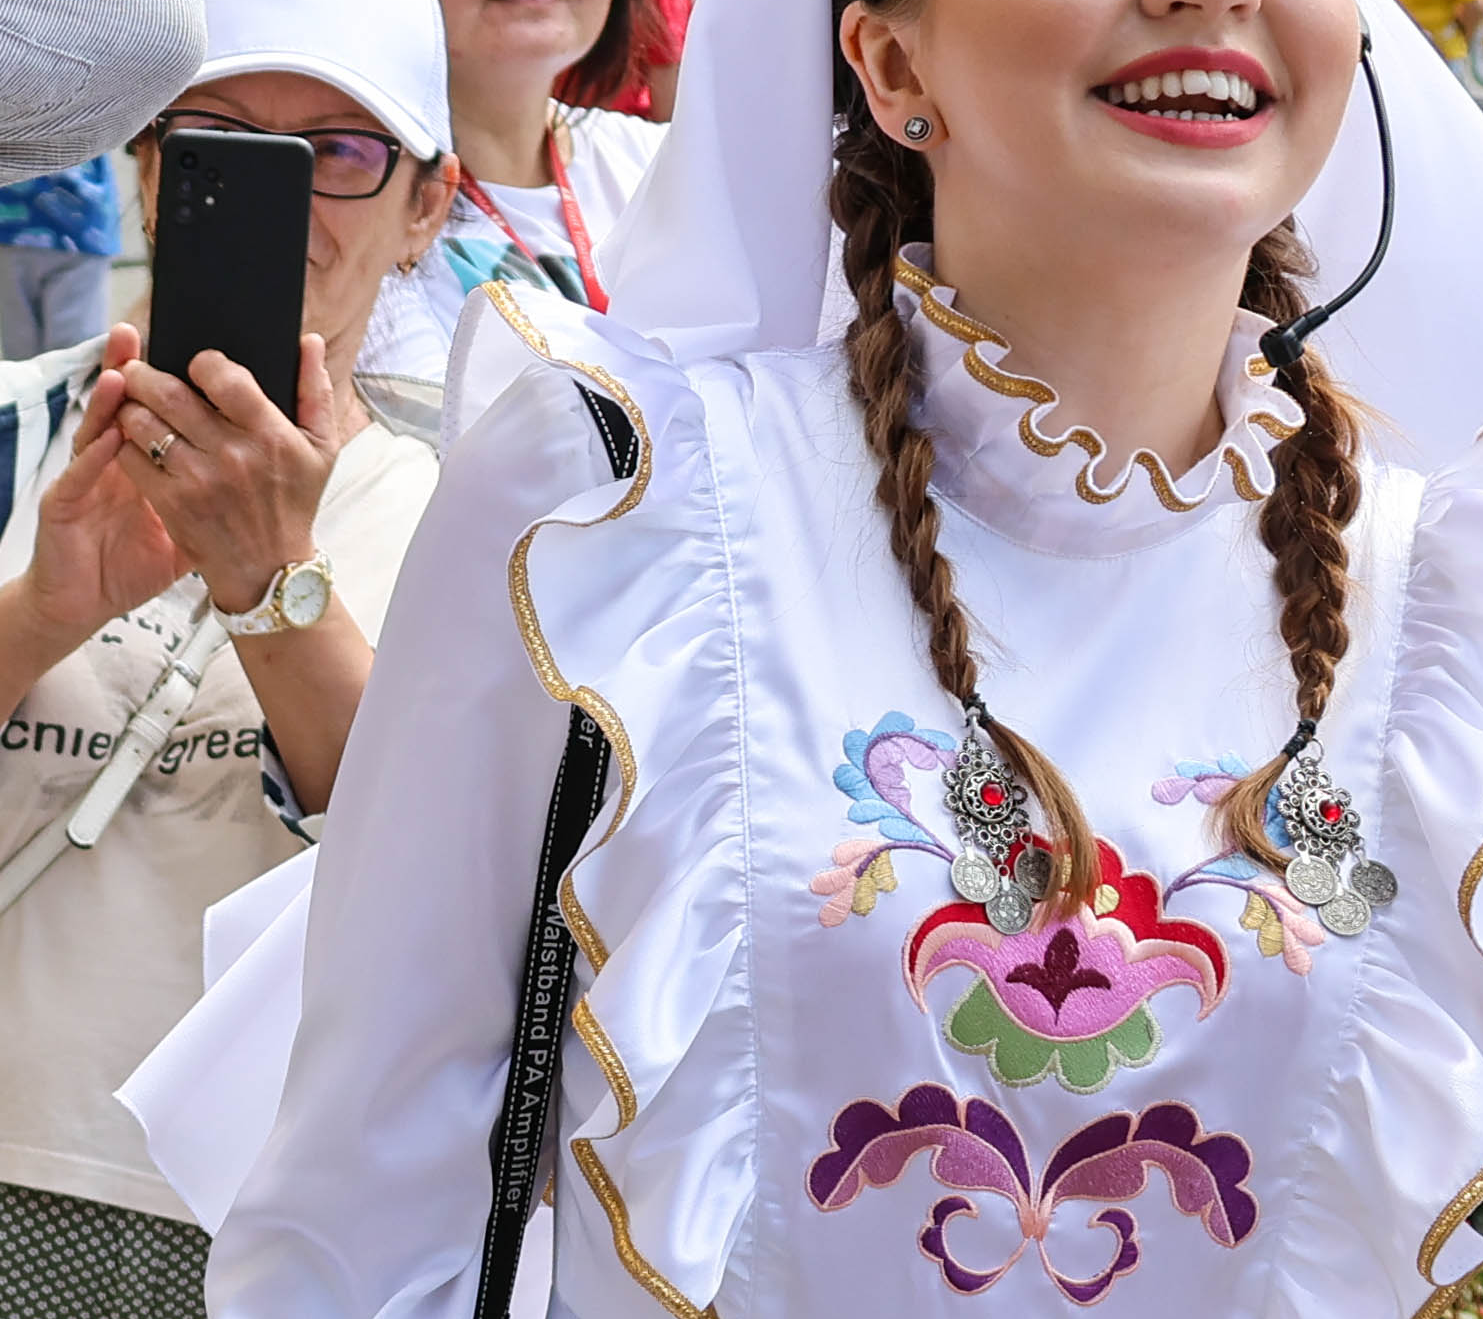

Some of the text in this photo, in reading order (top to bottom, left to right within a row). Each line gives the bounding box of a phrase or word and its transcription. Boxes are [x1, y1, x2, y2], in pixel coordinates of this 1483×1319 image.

[159, 727, 261, 775] grea
[505, 903, 567, 1213] Waistband PA Amplifier
